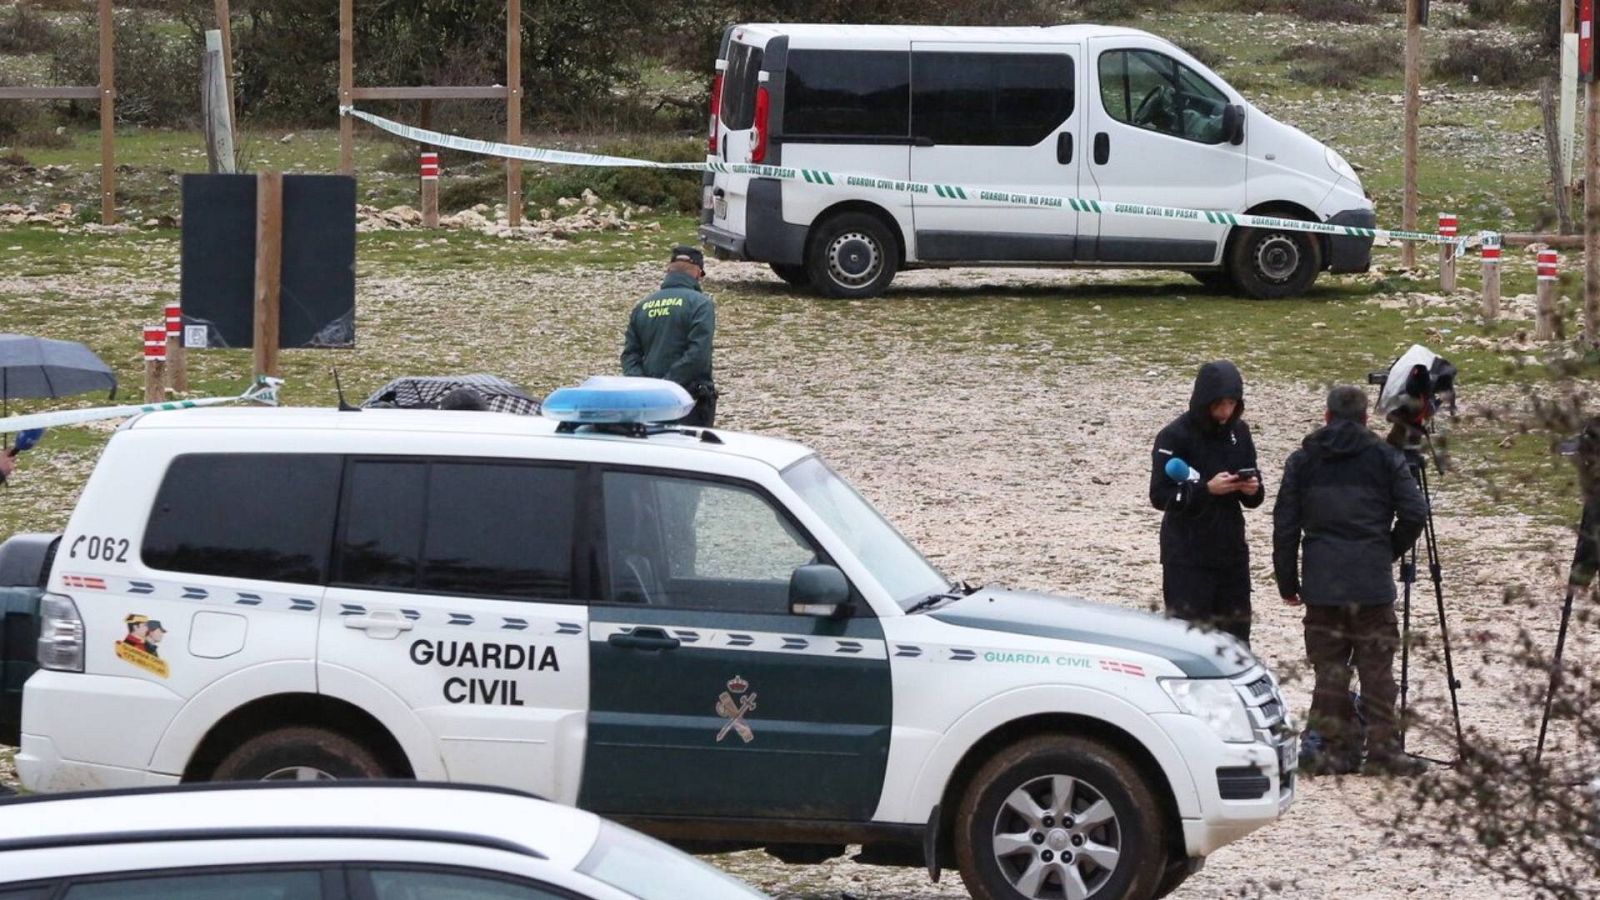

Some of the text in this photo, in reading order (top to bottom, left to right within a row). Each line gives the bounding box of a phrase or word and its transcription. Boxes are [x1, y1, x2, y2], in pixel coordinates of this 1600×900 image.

[774, 167, 796, 179] PASAR
[847, 176, 928, 194] GUARDIA CIVIL NO PASAR
[980, 190, 1062, 208] GUARDIA CIVIL NO PASAR
[1115, 203, 1198, 219] GUARDIA CIVIL NO PASAR
[642, 298, 683, 310] GUARDIA
[648, 307, 671, 318] CIVIL
[88, 535, 129, 563] 062
[409, 639, 560, 672] GUARDIA
[984, 651, 1093, 669] GUARDIA CIVIL
[443, 677, 524, 706] CIVIL
